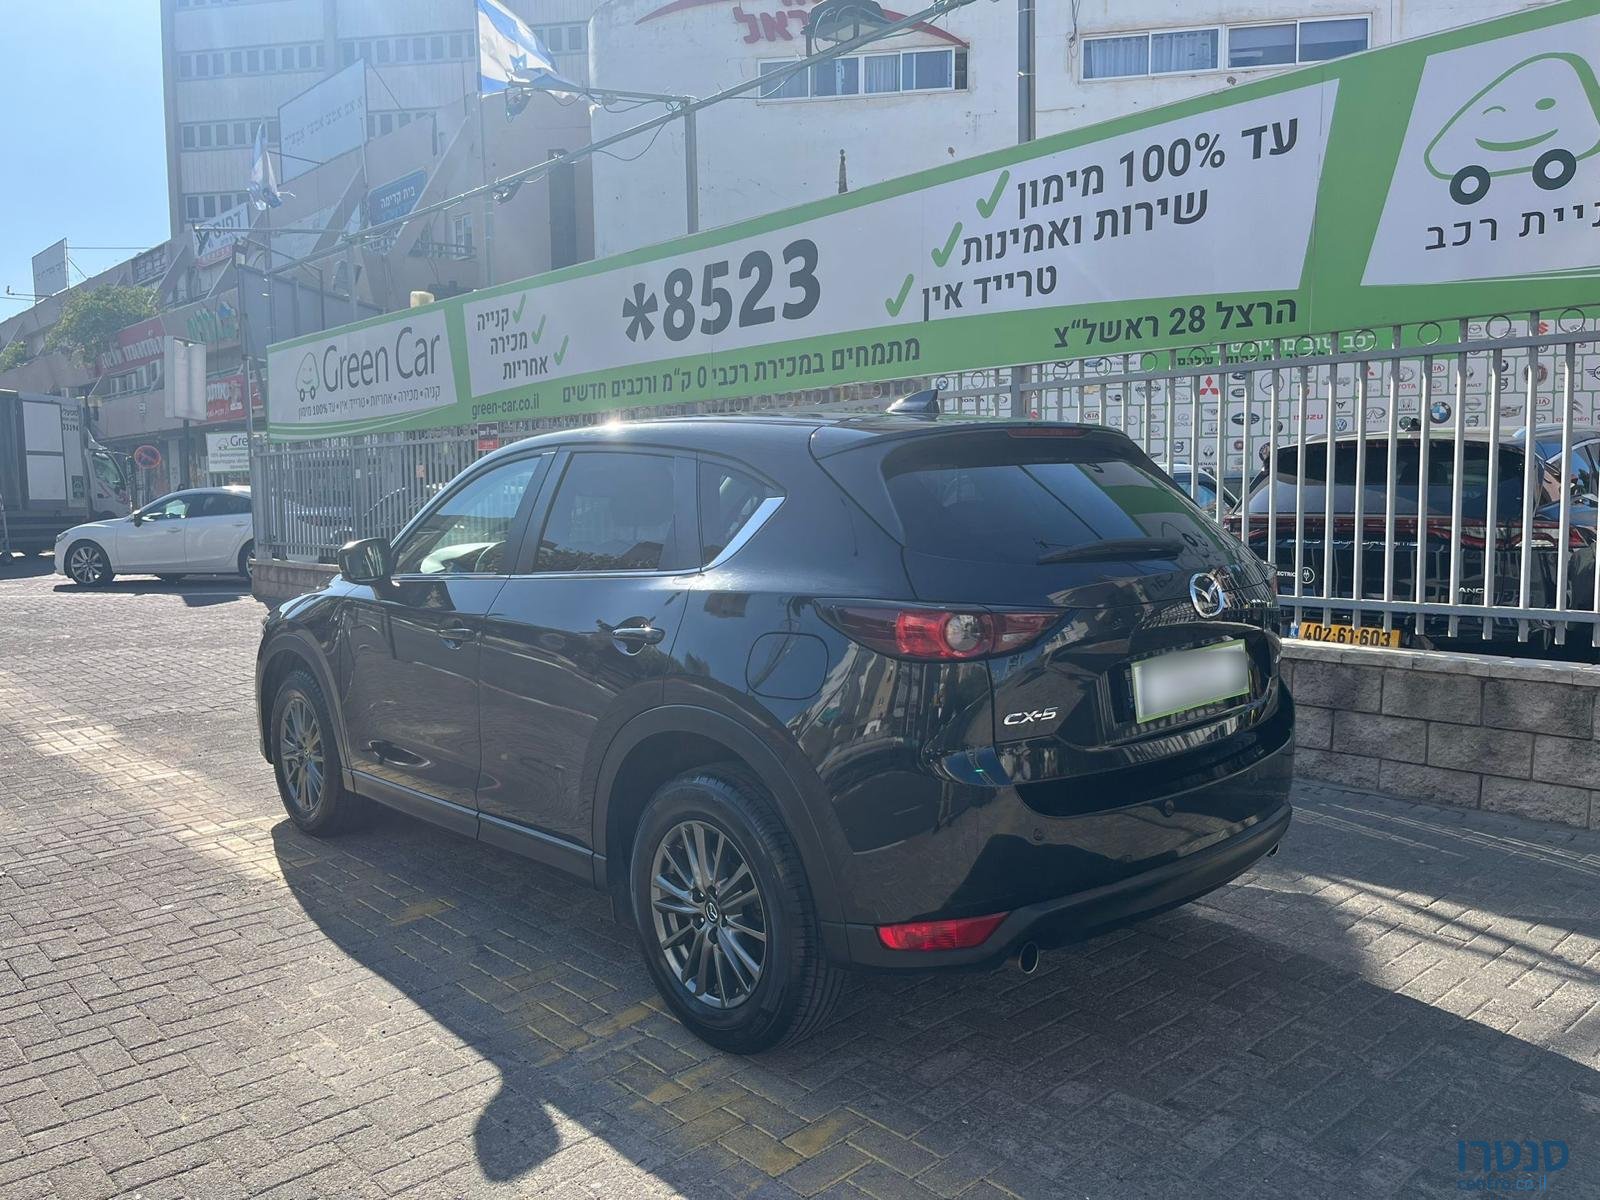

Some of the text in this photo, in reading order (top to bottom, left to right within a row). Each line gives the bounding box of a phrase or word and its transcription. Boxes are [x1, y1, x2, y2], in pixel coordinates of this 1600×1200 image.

[1017, 117, 1299, 219] עד 100% מימון
[961, 189, 1208, 266] שירות ואמינות
[1425, 218, 1497, 250] רכב
[921, 264, 1058, 322] טרייד אין
[477, 308, 509, 332] קנייה
[1169, 306, 1206, 337] 28
[1216, 298, 1297, 331] הרצל
[490, 331, 528, 355] מכירה
[831, 337, 921, 372] מתמחים
[323, 326, 440, 392] Green Car
[503, 355, 549, 380] אחריות
[754, 352, 826, 388] במכירת
[612, 375, 658, 398] ורכבים
[712, 363, 750, 387] רכבי
[1387, 383, 1417, 391] TYOTA
[472, 393, 540, 420] green-car.co.il
[562, 382, 608, 403] חדשים
[1003, 707, 1059, 726] CX-5
